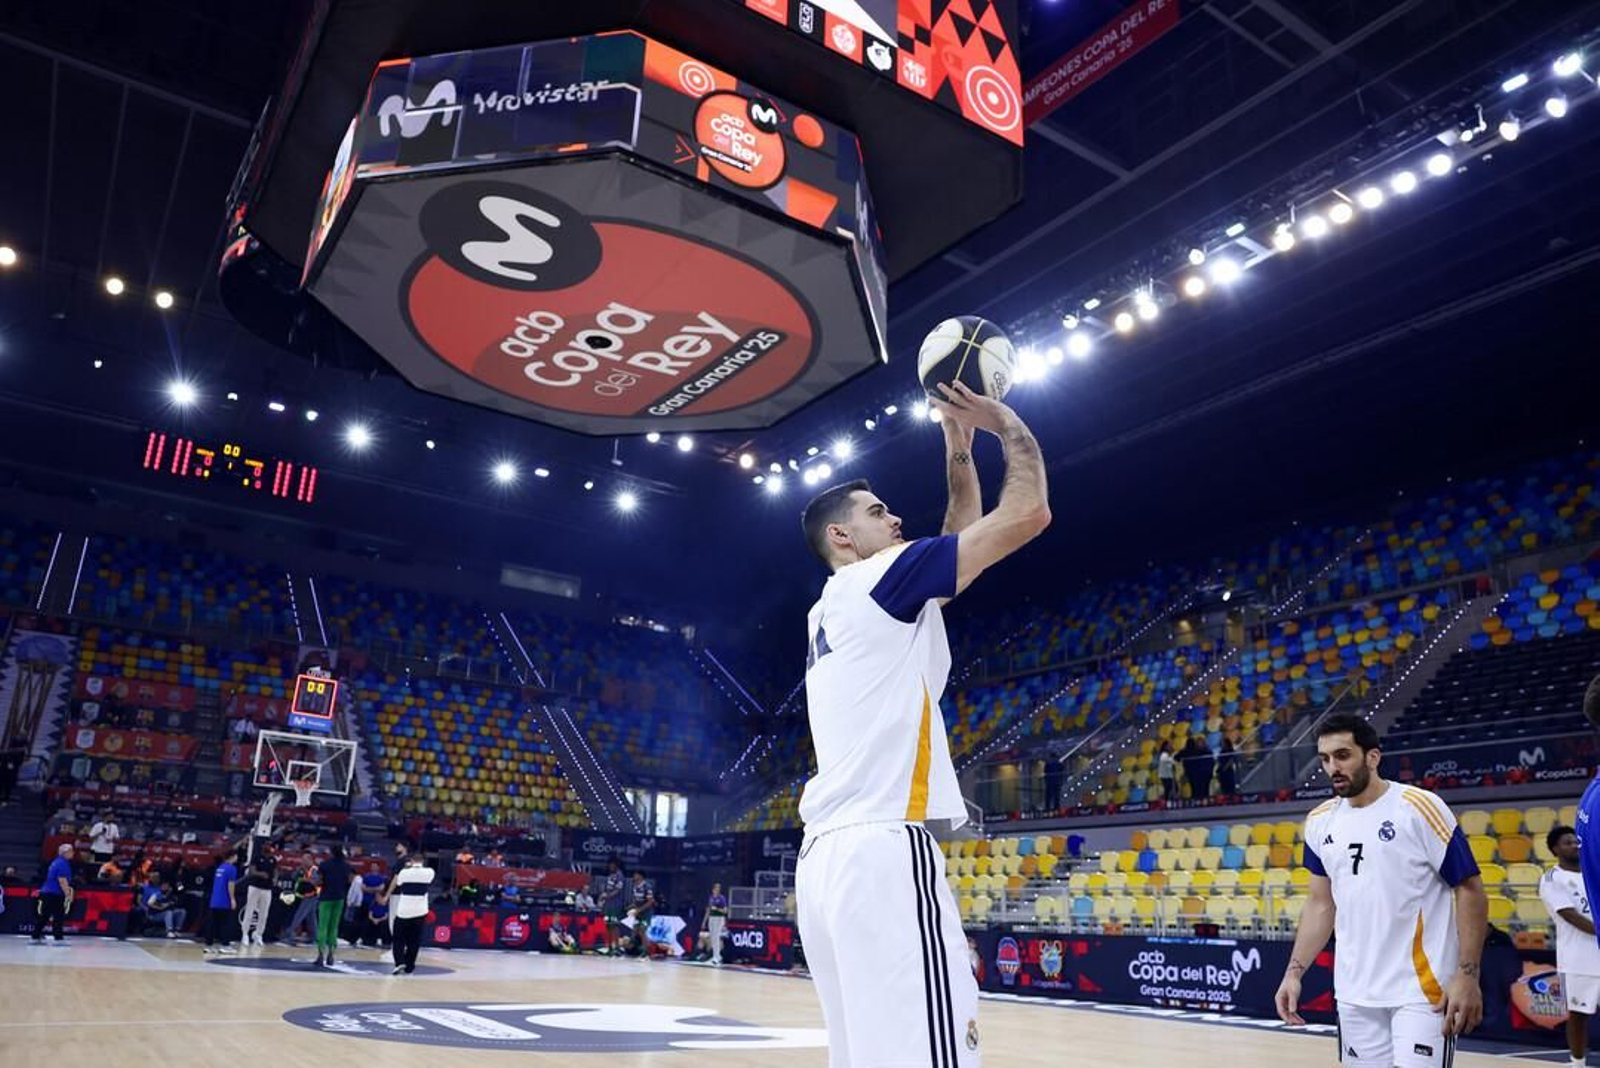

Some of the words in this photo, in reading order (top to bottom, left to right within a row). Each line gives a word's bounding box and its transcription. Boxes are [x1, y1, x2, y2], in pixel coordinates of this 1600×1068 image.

[1024, 53, 1082, 104] MPEONES
[1083, 29, 1118, 61] COPA
[1121, 10, 1147, 35] DEL
[1148, 0, 1172, 15] RE
[711, 118, 755, 146] Copa
[732, 142, 762, 166] Rey
[500, 310, 565, 357] acb
[524, 301, 655, 387] Copa
[594, 368, 641, 397] del
[627, 311, 742, 376] Rey
[649, 393, 684, 417] Gran
[682, 346, 754, 394] Canaria
[745, 330, 780, 354] '25
[1433, 760, 1458, 771] acb
[1348, 843, 1364, 875] 7
[731, 930, 764, 948] aACB
[1138, 950, 1165, 964] acb
[1129, 960, 1179, 984] Copa
[1181, 967, 1203, 981] del
[1205, 965, 1242, 991] Rey
[1140, 984, 1165, 997] Gran
[1165, 986, 1206, 1000] Canaria
[1207, 989, 1232, 1002] 2025
